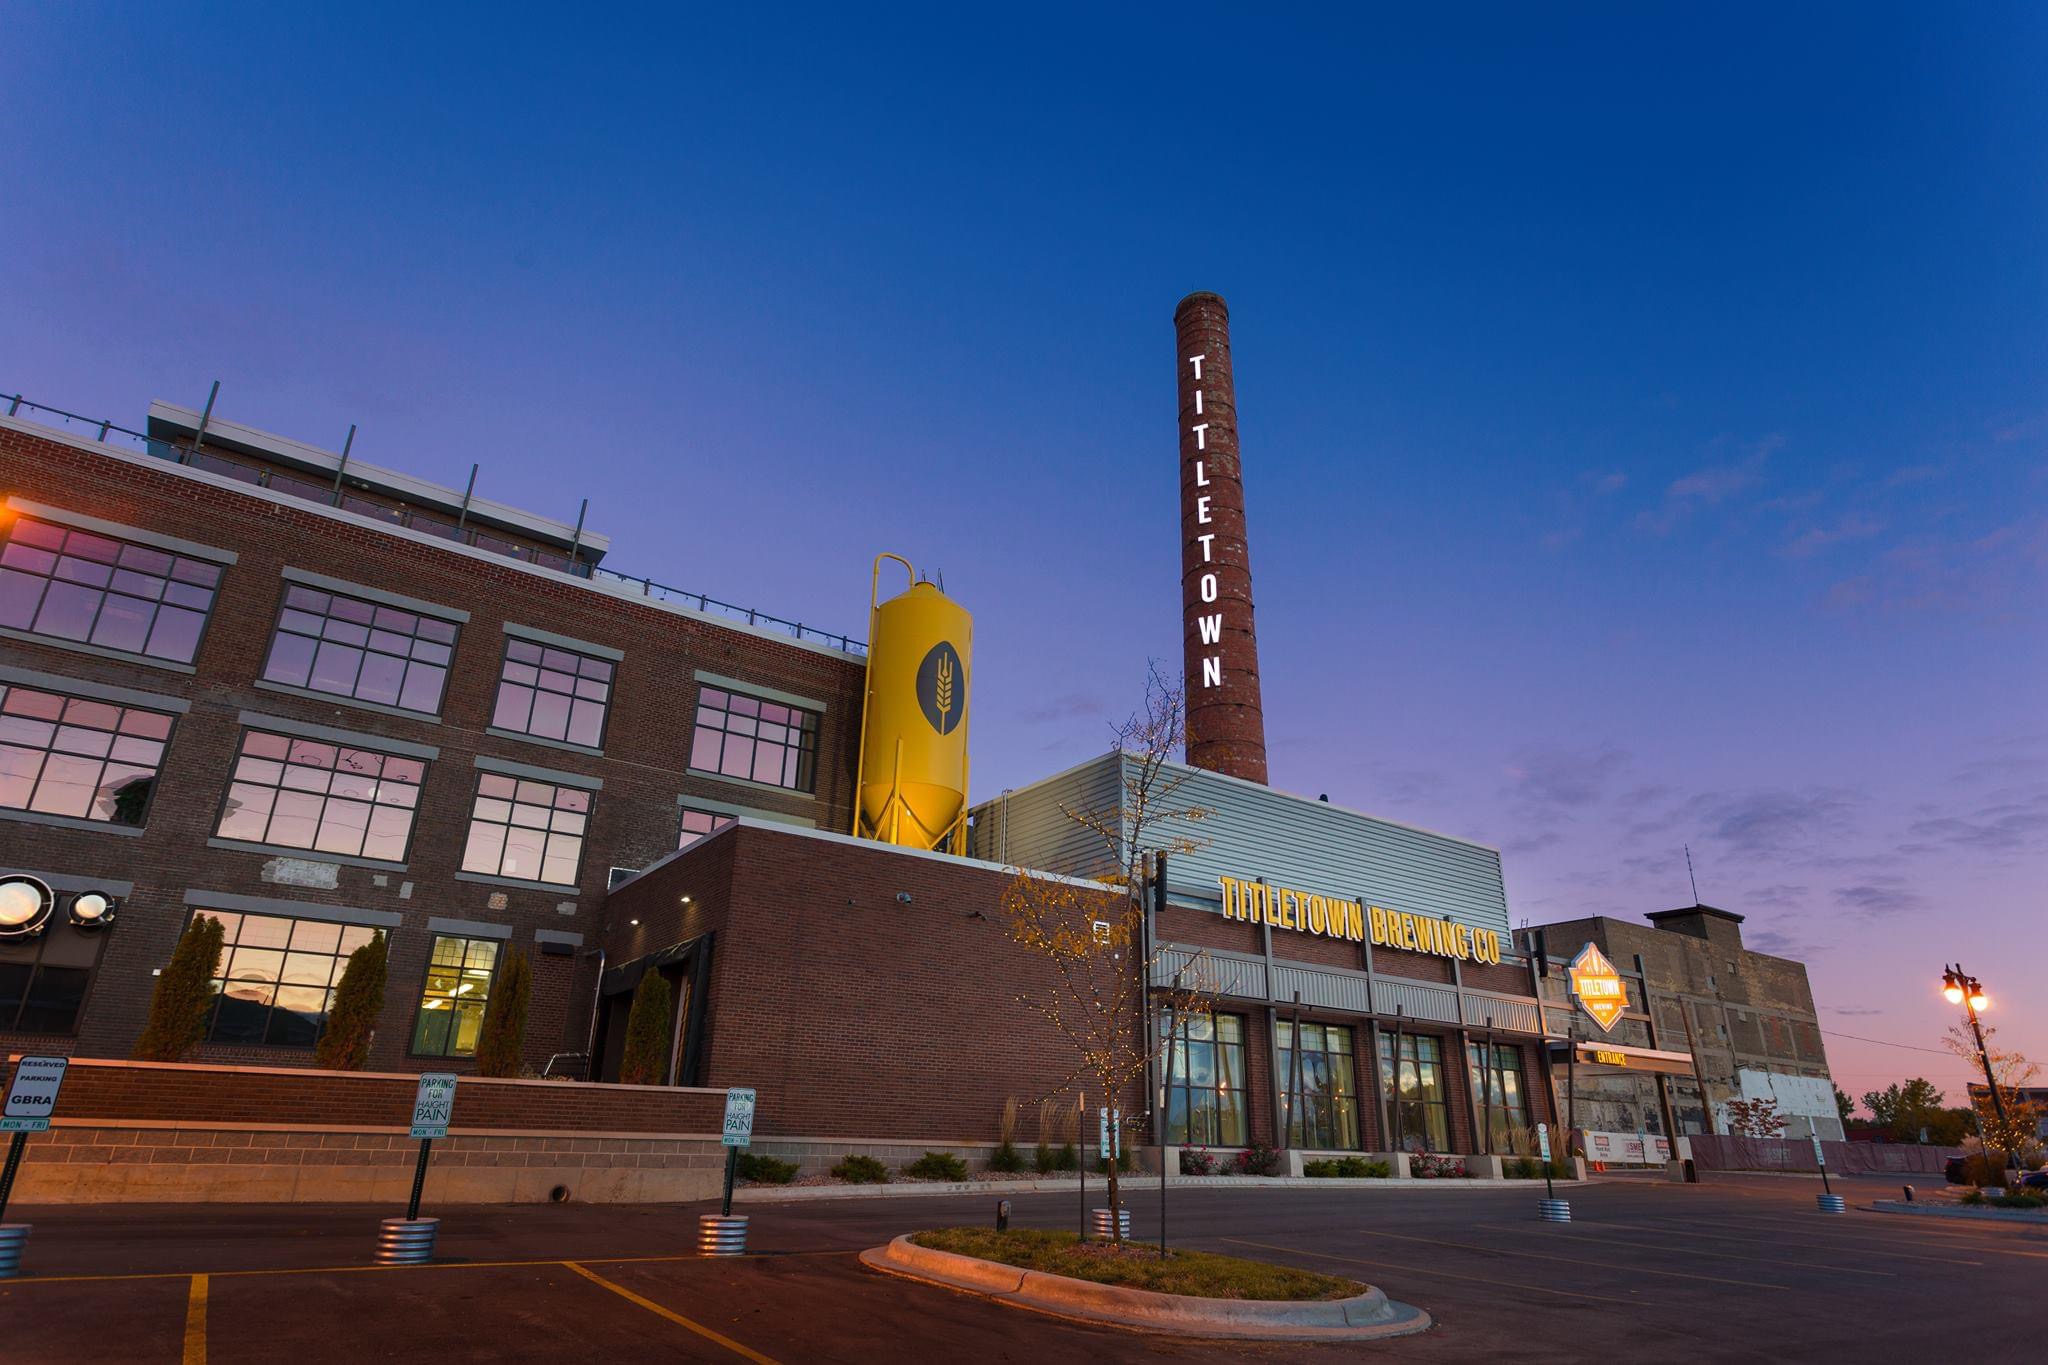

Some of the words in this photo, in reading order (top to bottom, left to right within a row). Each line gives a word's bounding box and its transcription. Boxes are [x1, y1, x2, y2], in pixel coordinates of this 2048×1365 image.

[1189, 355, 1222, 688] TITLETOWN
[1218, 875, 1364, 942] TITLETOWN
[1368, 905, 1469, 960] BREWING
[1471, 926, 1499, 965] CO
[1580, 979, 1620, 996] TITLETOWN
[1597, 1050, 1627, 1066] ENTRANCE
[21, 1060, 65, 1068] RESERVED
[421, 1078, 454, 1089] PARKING
[428, 1088, 444, 1099] FOR
[728, 1092, 754, 1102] PARKING
[11, 1095, 52, 1105] GBRA
[417, 1100, 449, 1109] HAIGHT
[415, 1108, 449, 1121] PAIN
[726, 1112, 752, 1120] HAIGHT
[2, 1120, 22, 1129] MON
[31, 1121, 47, 1129] FRI
[725, 1119, 751, 1131] PAIN
